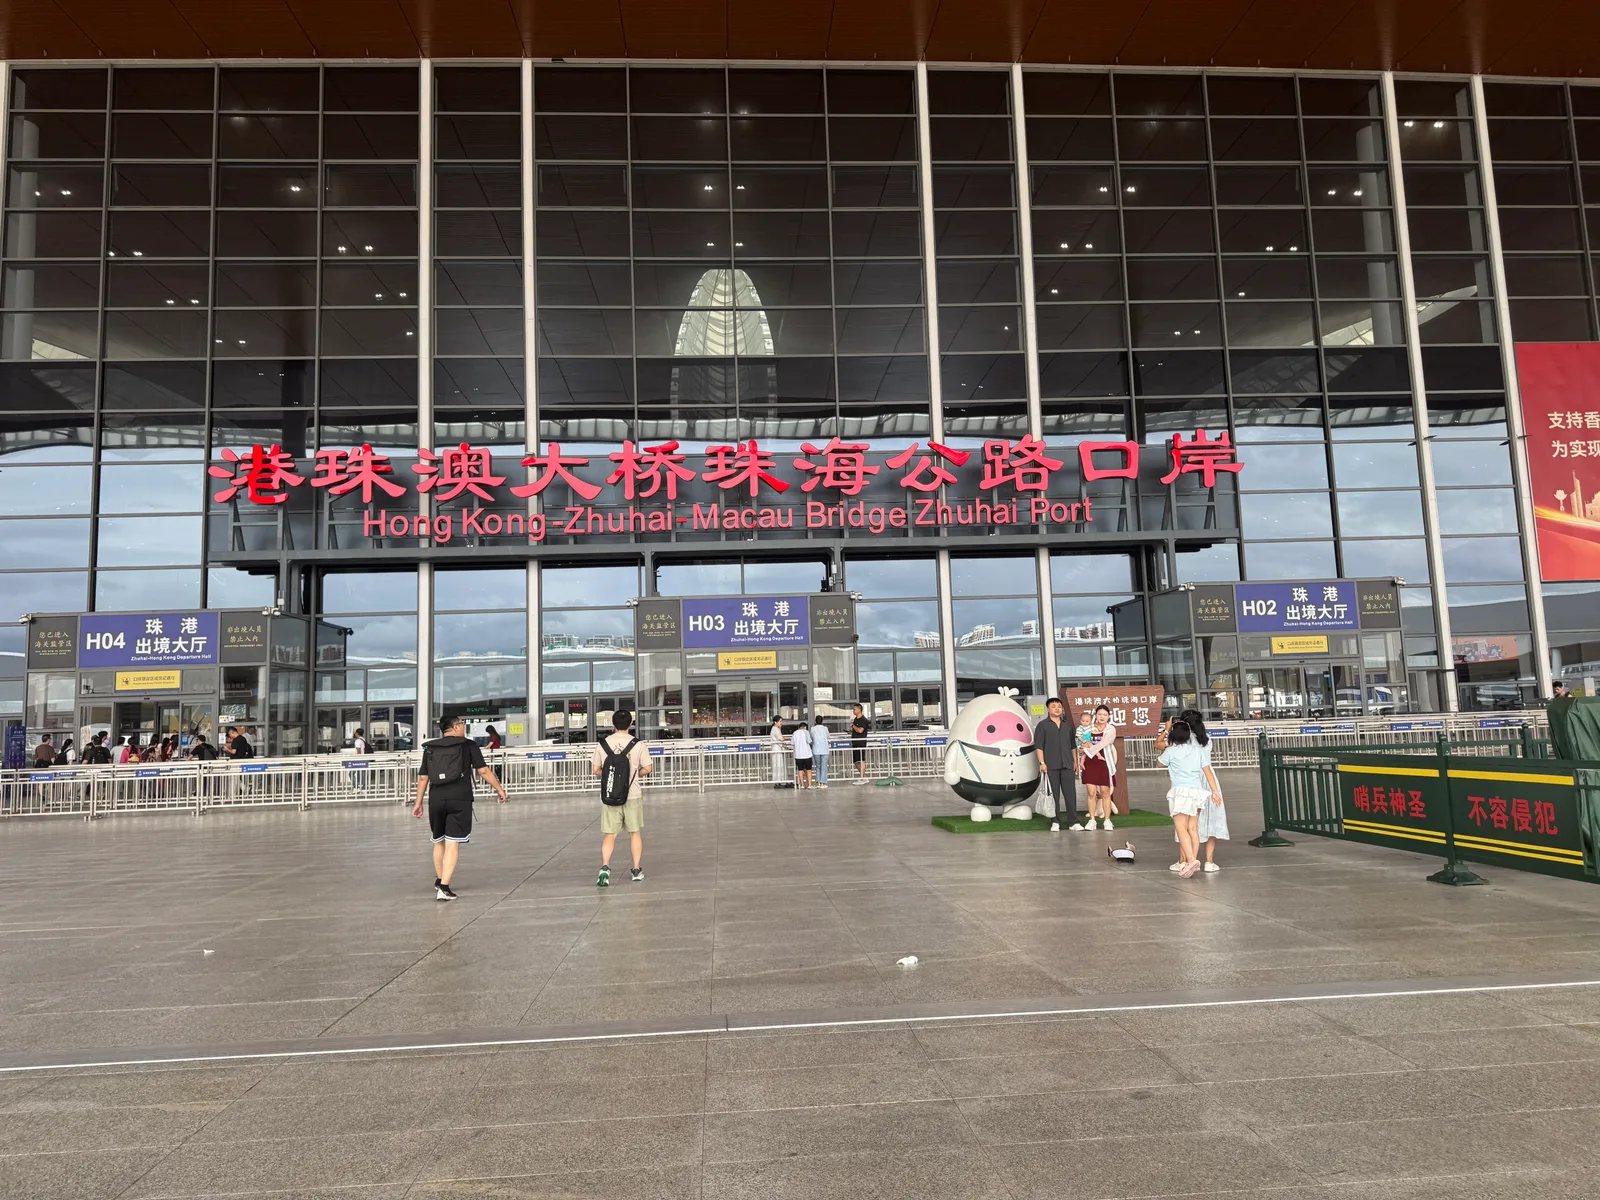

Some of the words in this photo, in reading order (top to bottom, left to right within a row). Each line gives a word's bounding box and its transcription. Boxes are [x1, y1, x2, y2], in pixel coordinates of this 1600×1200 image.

[1546, 411, 1600, 429] 支持香
[1551, 439, 1600, 458] 为实现
[207, 429, 1245, 505] 港珠澳大桥珠海公路口岸
[364, 508, 452, 543] Hong
[807, 501, 907, 535] Bridge
[915, 497, 1018, 526] Zhuhai
[1030, 496, 1094, 525] Port
[1242, 599, 1278, 616] H02
[1286, 603, 1348, 621] 出境大厅
[689, 615, 725, 631] H03
[734, 619, 799, 636] 出境大厅
[86, 632, 126, 650] H04
[135, 636, 207, 655] 出境大厅
[1353, 785, 1427, 819] 哨兵神圣
[1467, 795, 1558, 836] 不容侵犯
